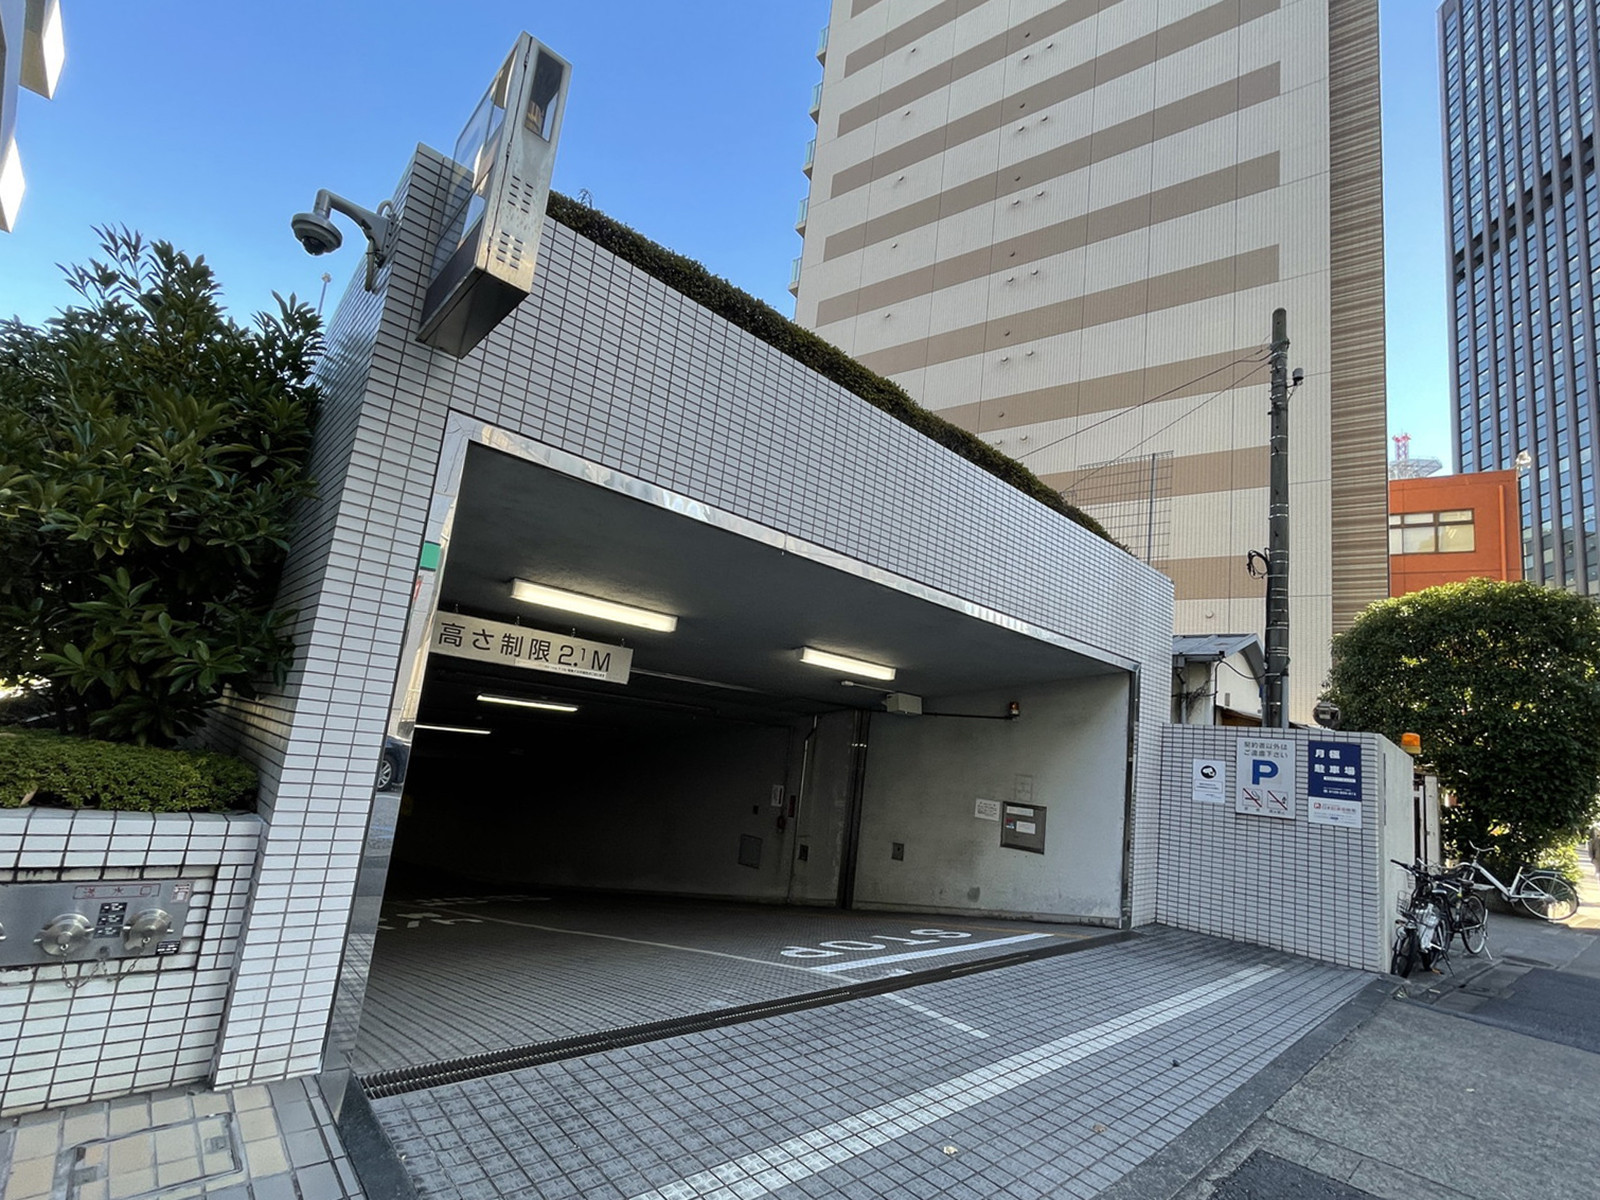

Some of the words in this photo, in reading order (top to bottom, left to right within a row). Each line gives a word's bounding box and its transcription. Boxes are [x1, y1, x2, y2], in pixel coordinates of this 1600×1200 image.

[1252, 759, 1279, 785] P
[1314, 764, 1356, 776] 駐車場
[780, 928, 972, 958] STOP
